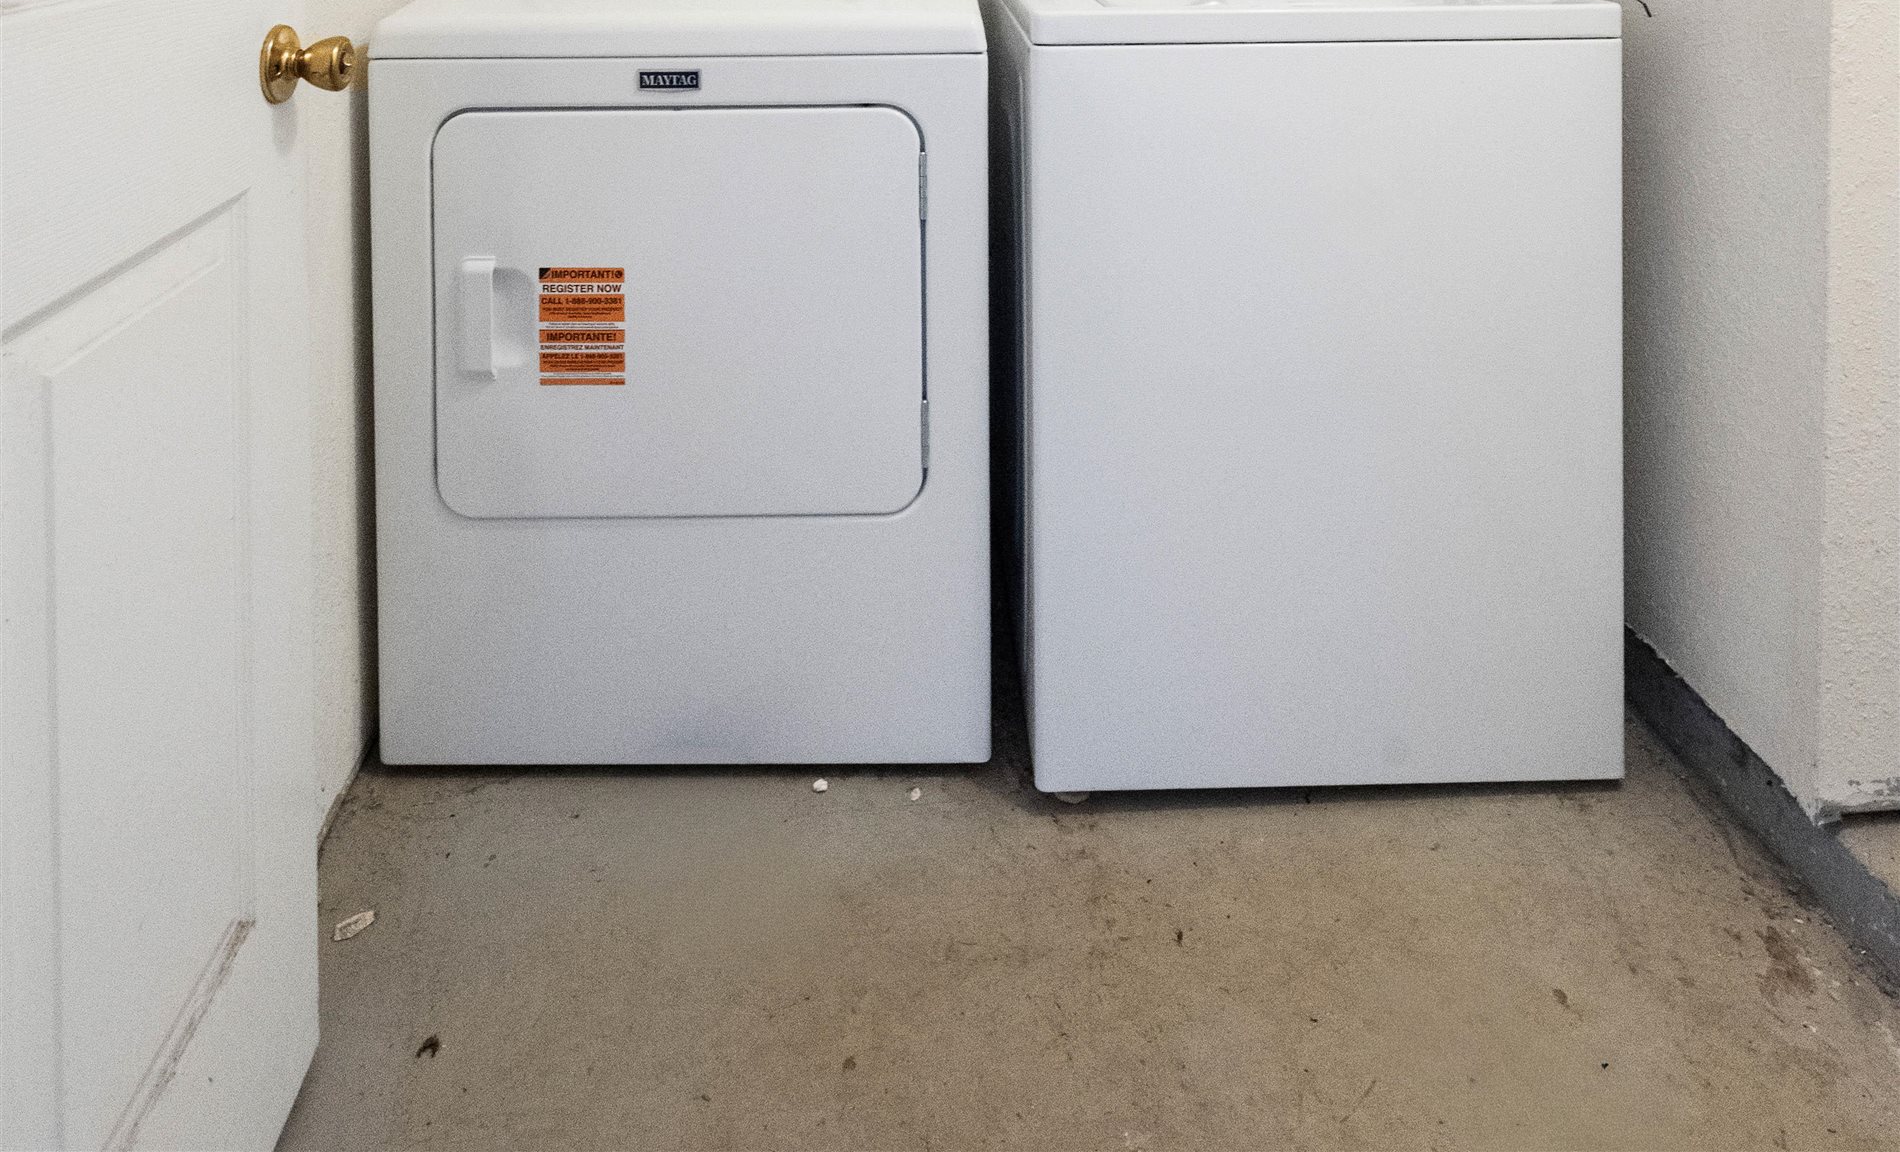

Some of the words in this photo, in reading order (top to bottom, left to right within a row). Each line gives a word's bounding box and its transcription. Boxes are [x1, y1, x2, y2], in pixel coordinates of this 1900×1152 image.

[641, 74, 697, 86] MAYTAG
[551, 270, 615, 279] IMPORTANT!
[542, 284, 594, 293] REGISTER
[597, 284, 622, 293] NOW
[541, 297, 563, 305] CALL
[546, 332, 617, 341] IMPORTANTE!
